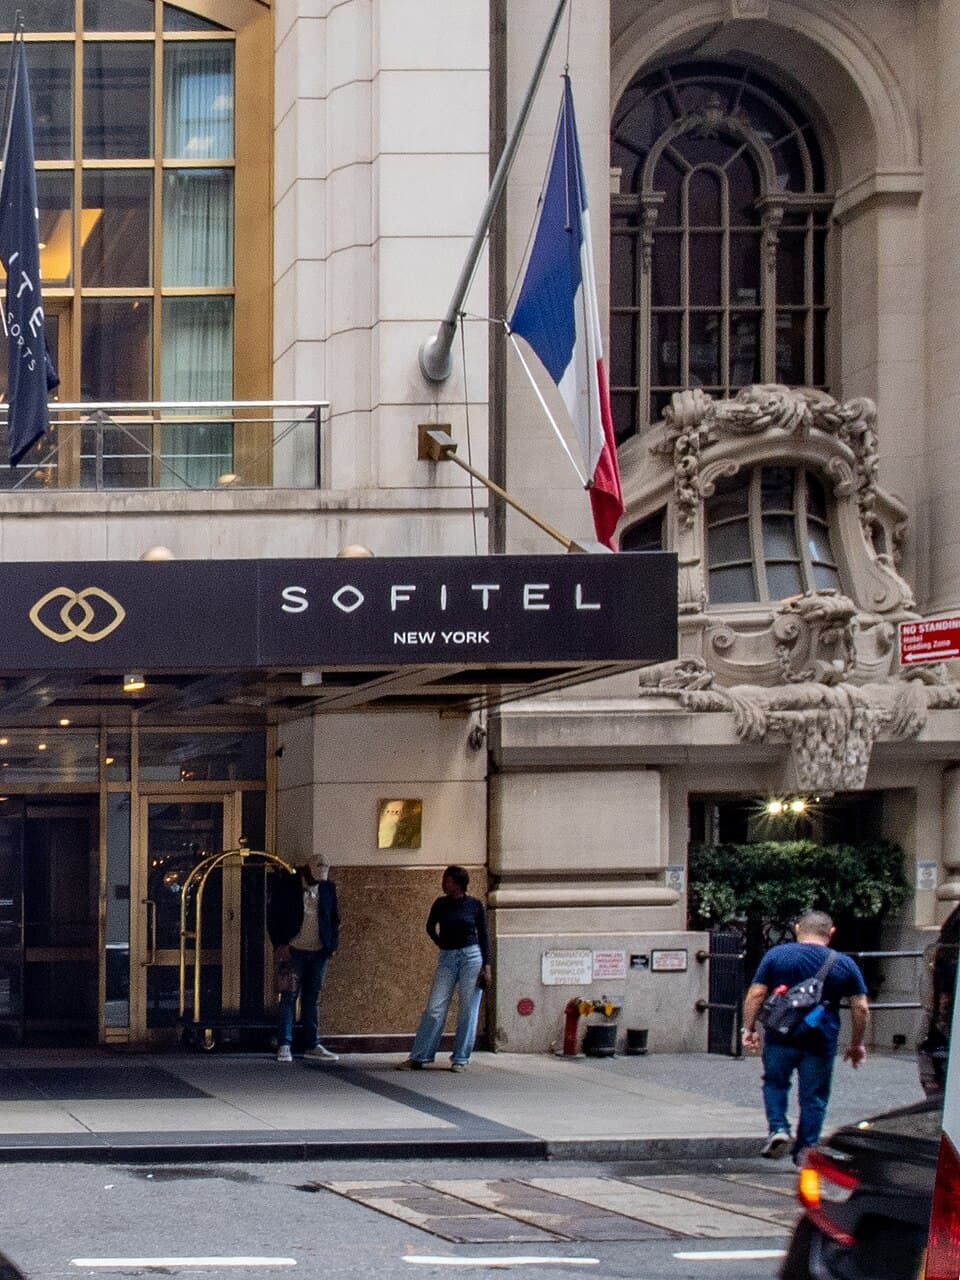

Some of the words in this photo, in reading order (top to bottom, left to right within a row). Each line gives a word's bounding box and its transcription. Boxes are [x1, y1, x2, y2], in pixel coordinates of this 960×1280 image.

[281, 583, 602, 614] SOFITEL
[903, 624, 917, 634] NO
[393, 631, 437, 646] NEW
[441, 631, 491, 646] YORK
